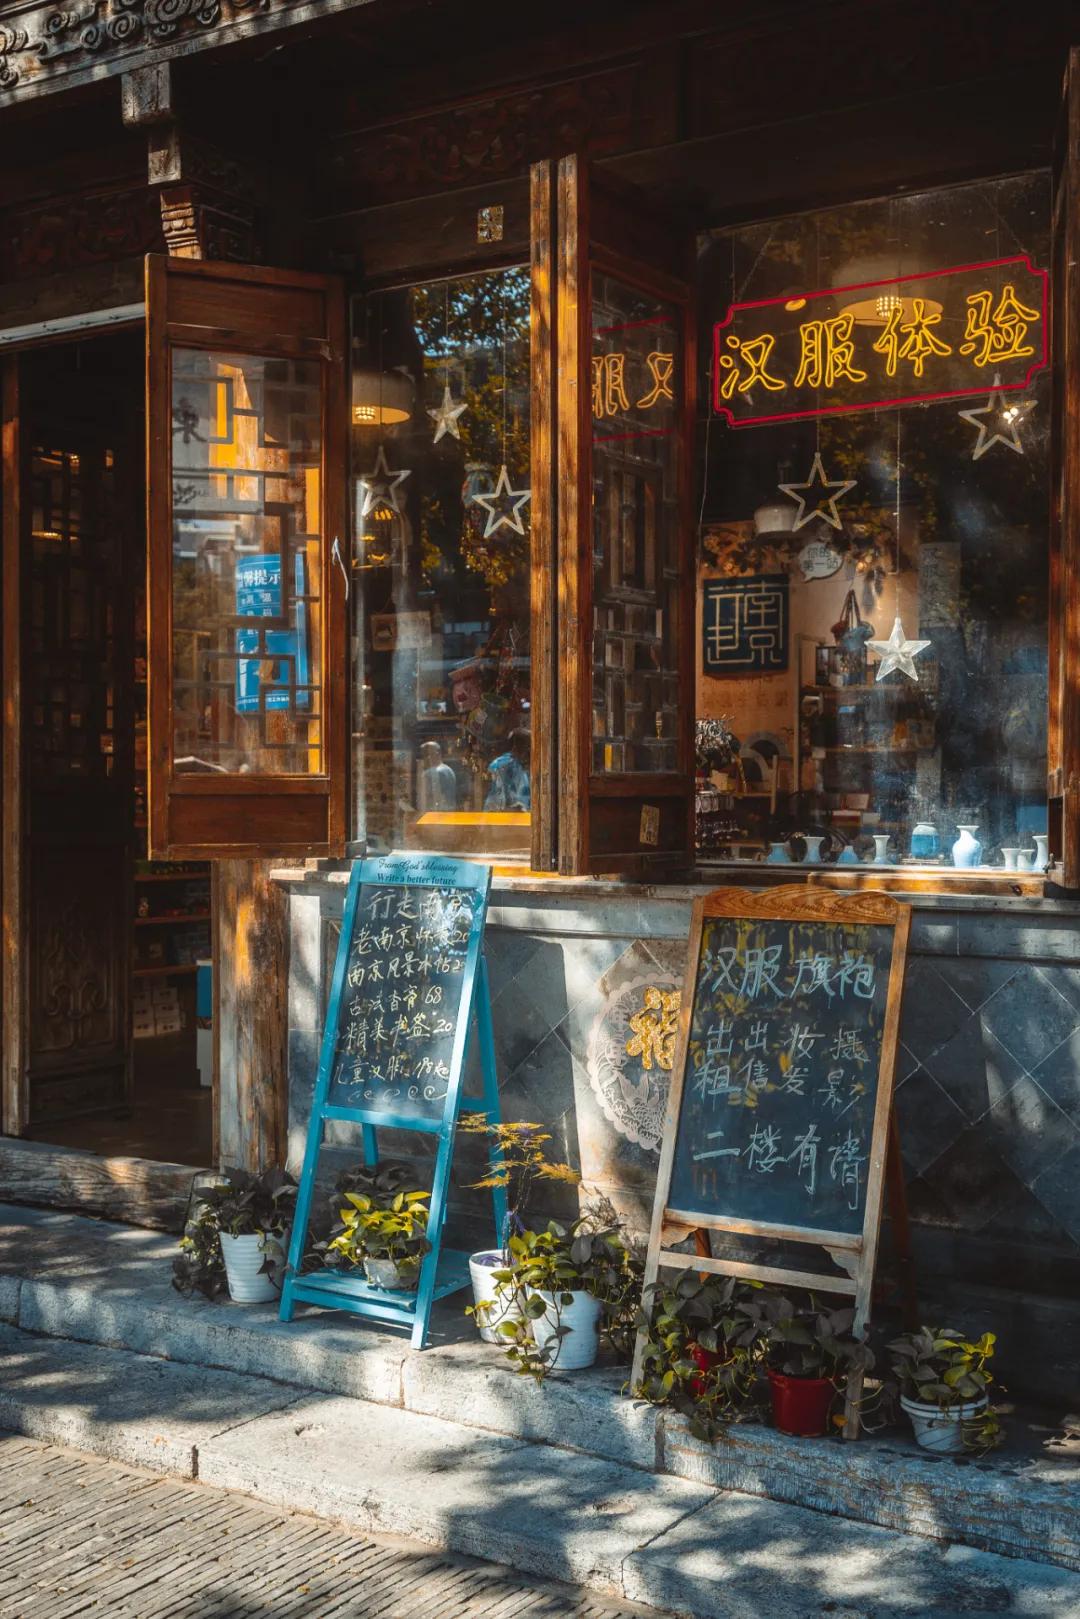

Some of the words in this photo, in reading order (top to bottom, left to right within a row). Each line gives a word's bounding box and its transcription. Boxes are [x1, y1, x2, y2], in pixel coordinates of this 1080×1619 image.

[719, 285, 1040, 399] 汉服体验
[377, 872, 400, 883] Write
[407, 874, 431, 884] better
[431, 875, 457, 885] future
[366, 887, 472, 921] 行走南
[702, 943, 876, 998] 汉服旗袍
[425, 985, 443, 1004] 68
[432, 1019, 453, 1034] 20
[692, 1122, 867, 1211] 二楼有请
